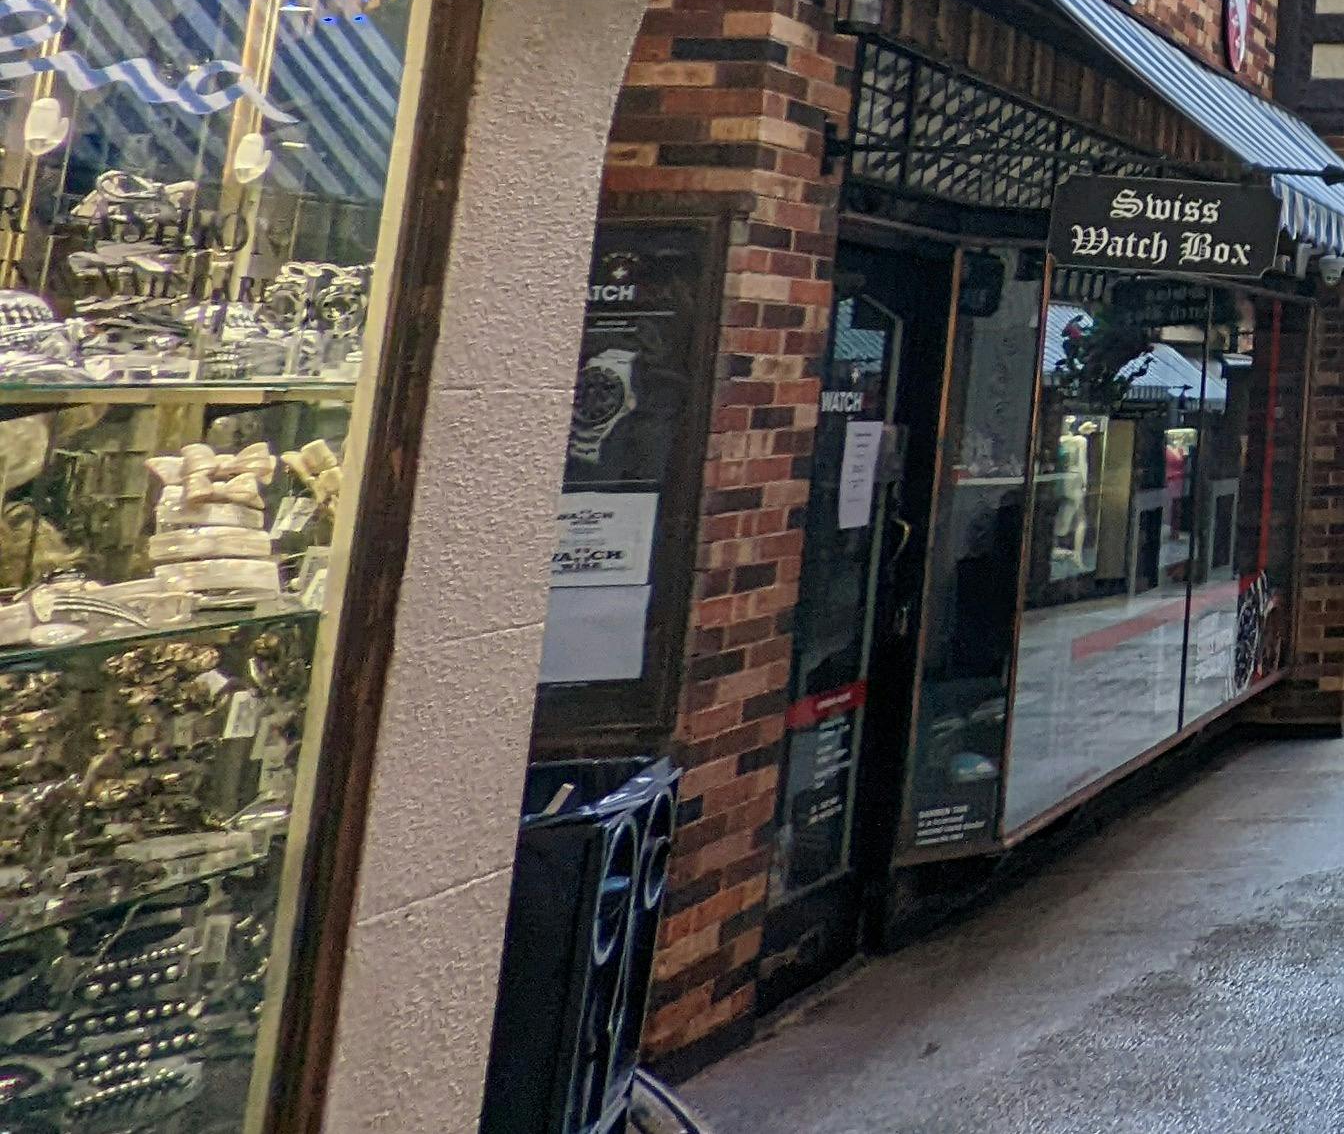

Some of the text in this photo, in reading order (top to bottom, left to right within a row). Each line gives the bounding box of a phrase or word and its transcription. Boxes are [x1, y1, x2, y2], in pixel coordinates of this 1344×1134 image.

[1110, 188, 1221, 224] Swiss
[1071, 224, 1251, 266] Watch Box
[822, 391, 863, 412] WATCH
